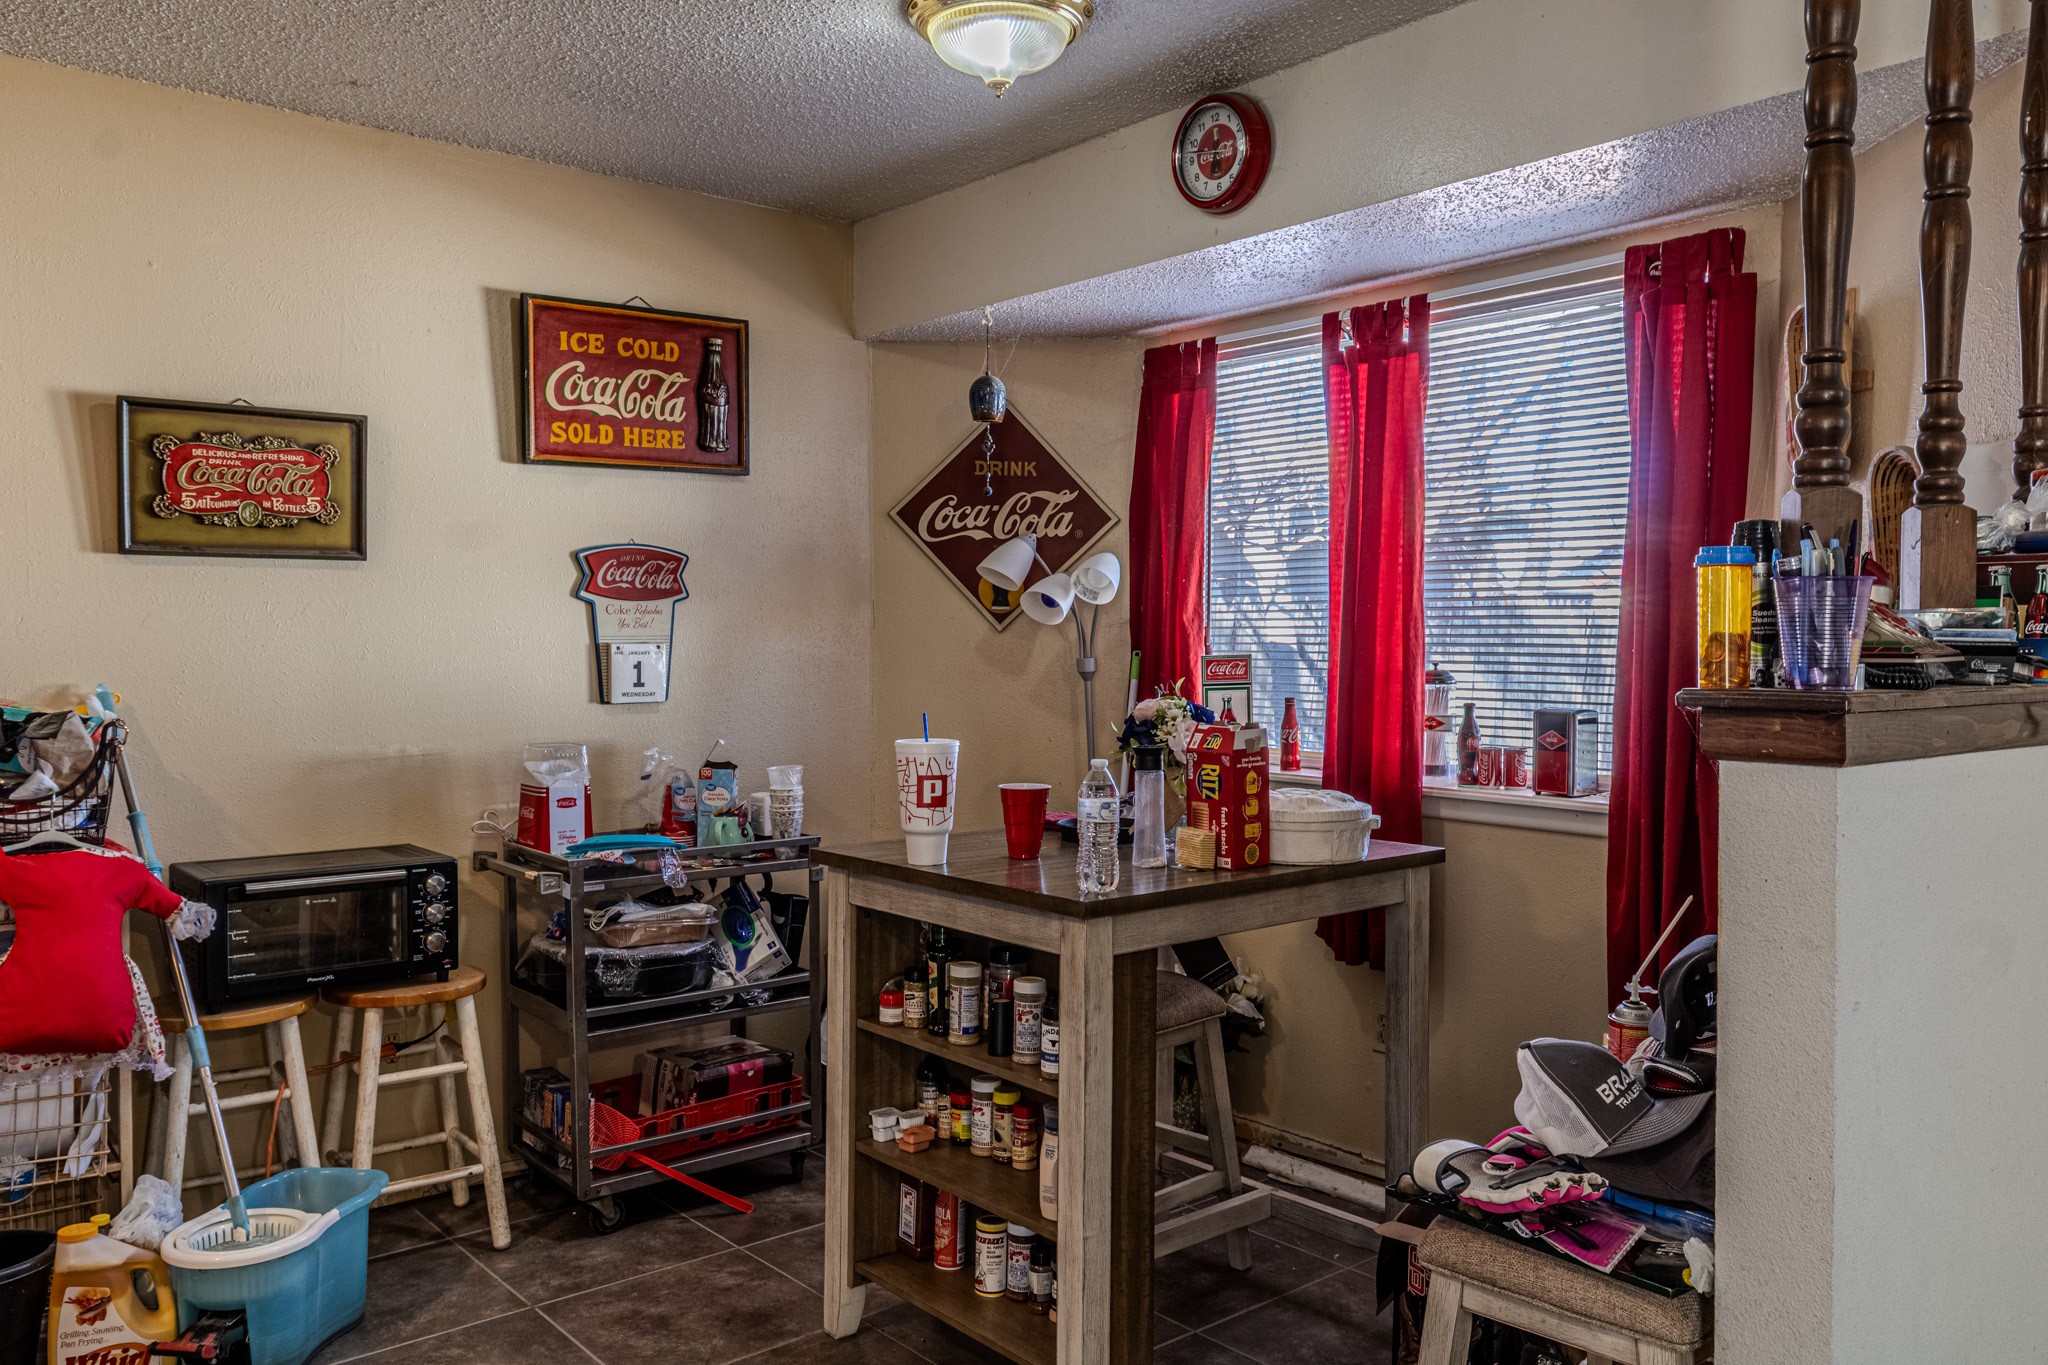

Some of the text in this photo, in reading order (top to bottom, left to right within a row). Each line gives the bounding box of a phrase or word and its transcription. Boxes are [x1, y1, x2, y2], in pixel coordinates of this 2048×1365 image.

[1211, 113, 1220, 123] 12
[1198, 123, 1206, 132] 11
[1189, 139, 1198, 149] 10
[1189, 157, 1195, 166] 9
[1195, 173, 1200, 182] 8
[1203, 182, 1208, 190] 7
[1216, 183, 1222, 191] 6
[559, 331, 680, 362] ICE COLD
[545, 360, 691, 423] Coca-Cola
[550, 421, 686, 449] SOLD HERE
[191, 448, 237, 459] DELICIOUS
[252, 452, 304, 462] REFRESHING
[208, 458, 242, 466] DRINK
[975, 460, 1037, 477] DRINK
[177, 458, 320, 496] Coca-Cola
[262, 500, 271, 508] IN
[270, 496, 306, 513] BOTTLES
[918, 489, 1079, 542] Coca-Cola
[597, 559, 678, 589] Coca-Cola
[605, 603, 663, 619] Coke Refreshes
[617, 617, 631, 632] You
[633, 660, 645, 688] 1
[1207, 660, 1246, 675] Coca-Cola
[1203, 736, 1223, 749] RITZ
[700, 769, 712, 777] 100
[1479, 753, 1489, 784] Coca-Cola
[1515, 753, 1526, 785] Coca-Cola
[1201, 763, 1221, 800] RITZ
[923, 779, 943, 804] P
[1220, 806, 1229, 855] fresh stacks
[60, 1341, 76, 1349] Pan
